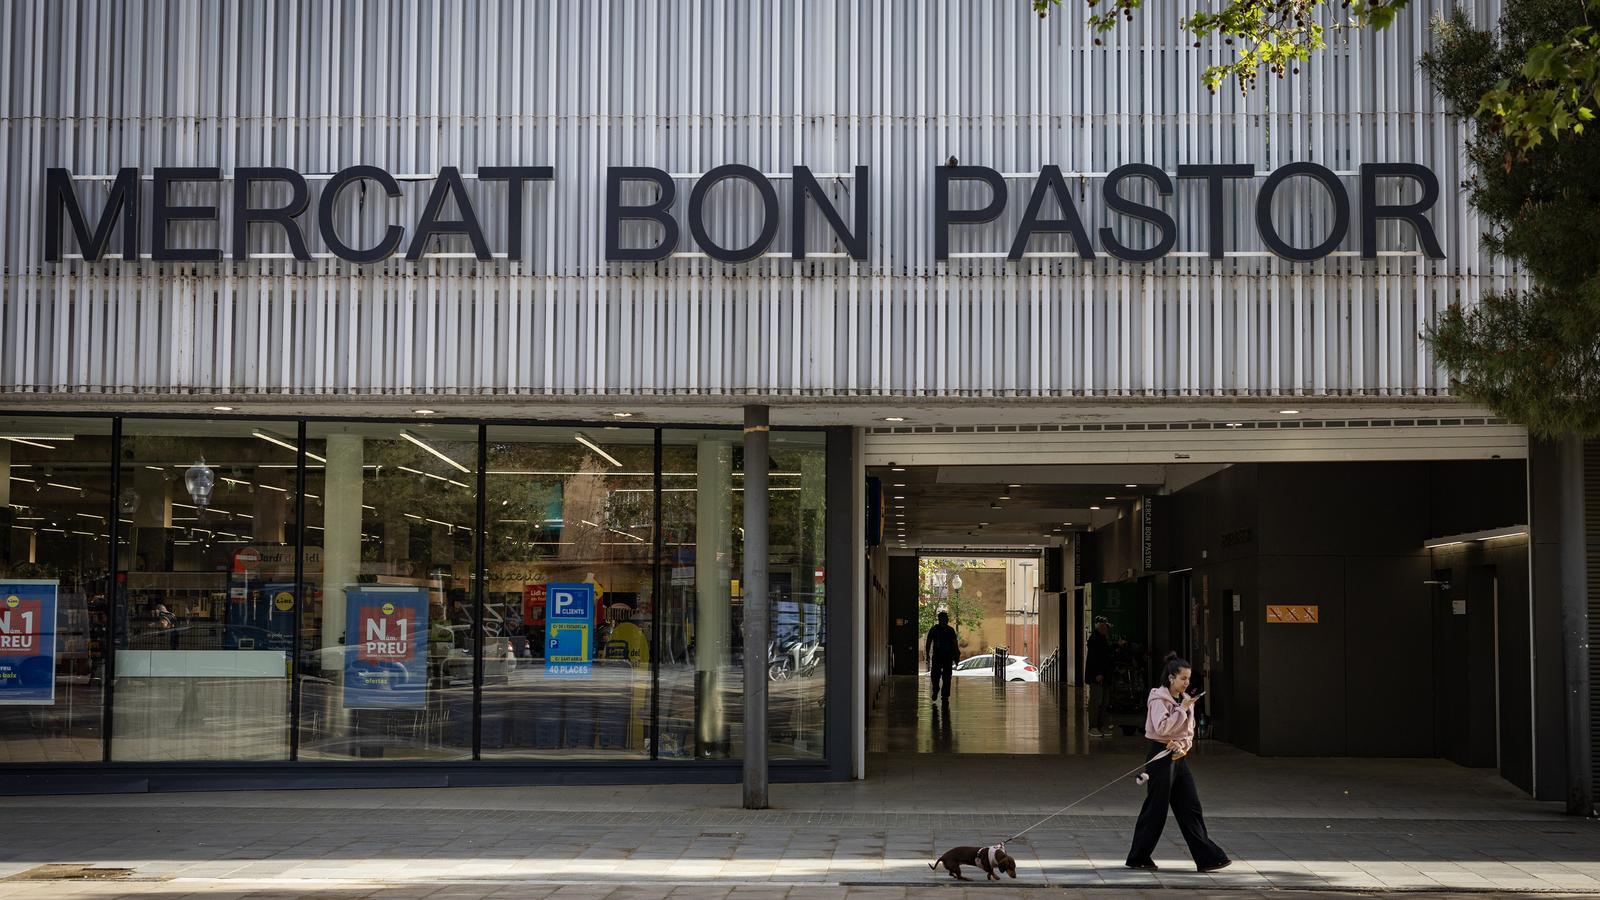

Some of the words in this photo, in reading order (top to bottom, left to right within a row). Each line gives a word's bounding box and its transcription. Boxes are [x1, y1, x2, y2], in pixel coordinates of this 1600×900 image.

[46, 165, 555, 264] MERCAT
[607, 163, 869, 264] BON
[936, 161, 1448, 263] PASTOR
[555, 592, 573, 614] P
[396, 618, 408, 641] 1
[0, 635, 32, 648] REU
[366, 642, 407, 654] PREU
[550, 639, 557, 648] P
[549, 665, 559, 673] 40
[560, 665, 588, 674] PLACES
